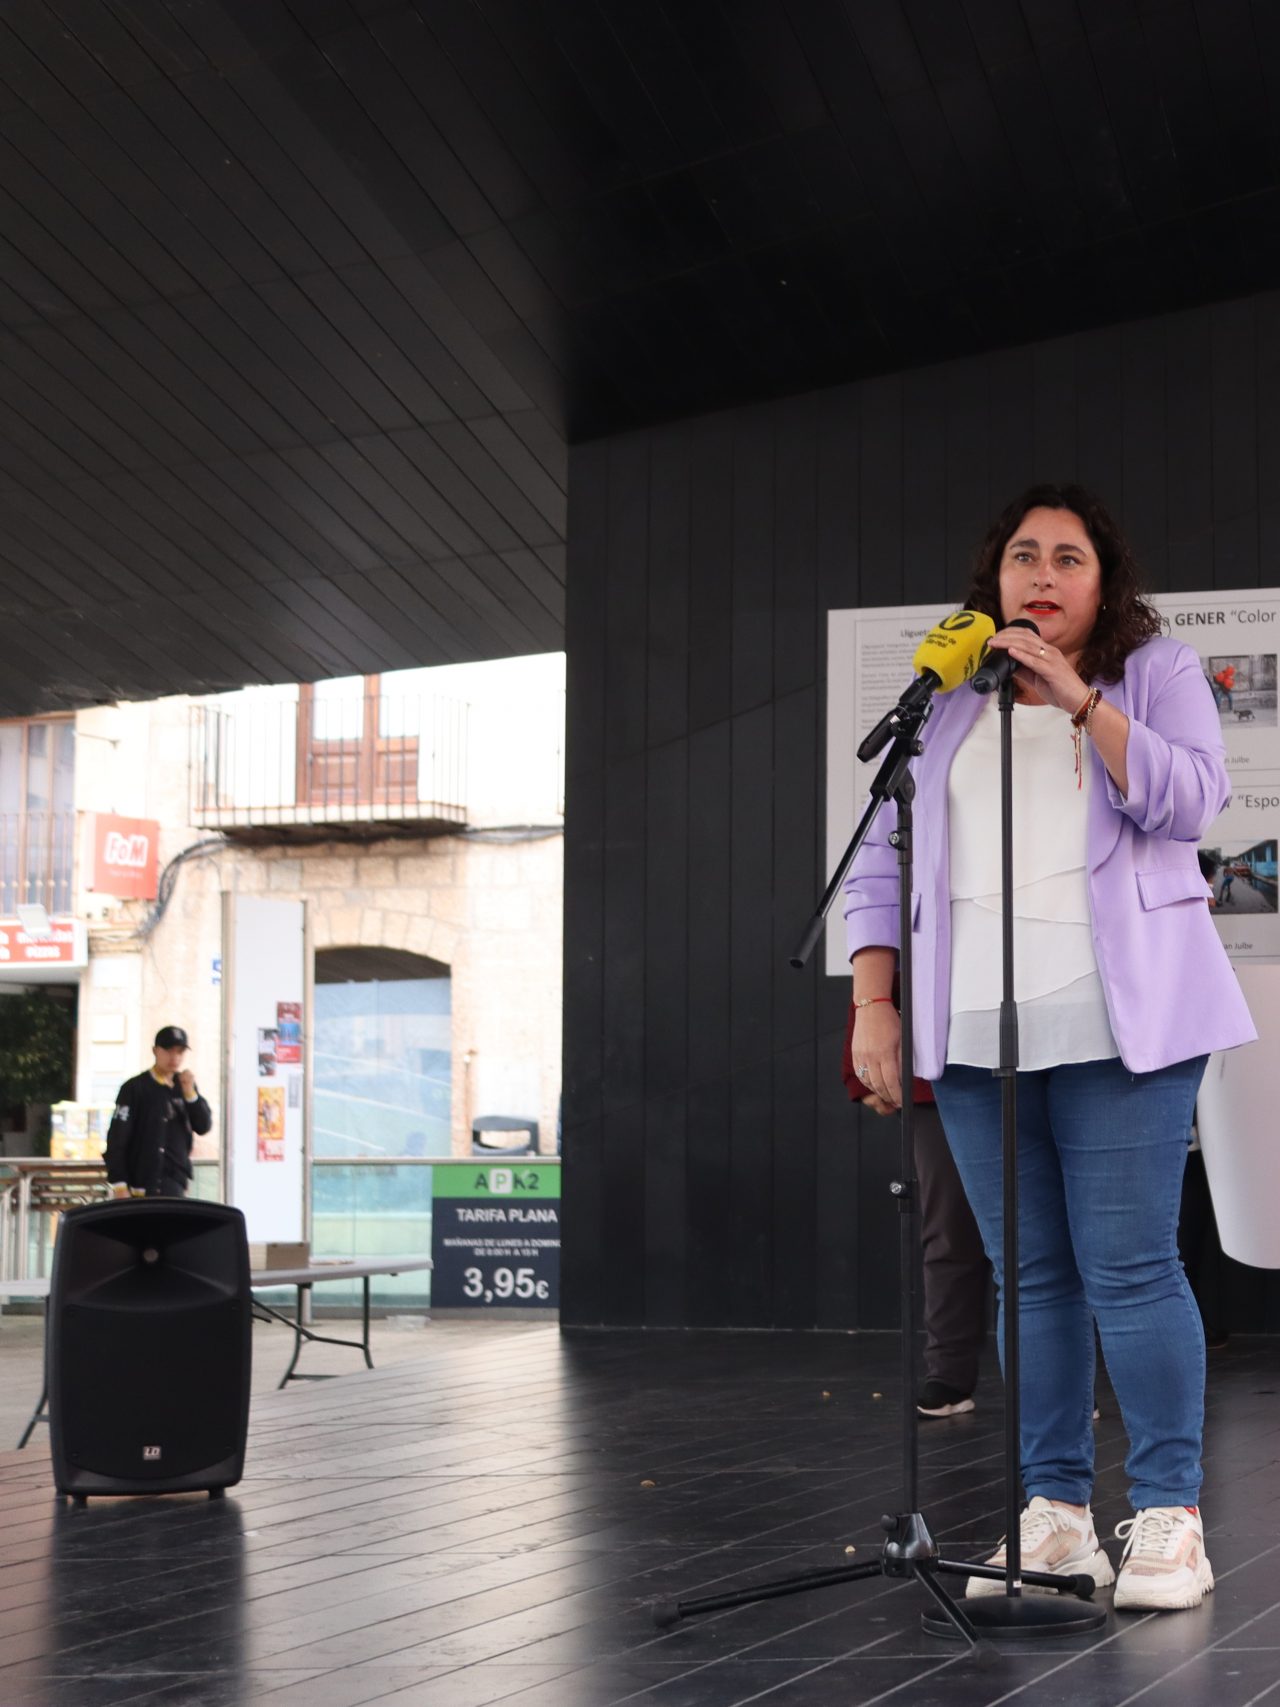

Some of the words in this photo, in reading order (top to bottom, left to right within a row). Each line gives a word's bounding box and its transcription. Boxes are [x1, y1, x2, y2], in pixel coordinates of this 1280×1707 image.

[1175, 612, 1225, 626] GENER
[456, 1208, 507, 1223] TARIFA
[509, 1208, 558, 1223] PLANA
[463, 1267, 550, 1303] 3,95€
